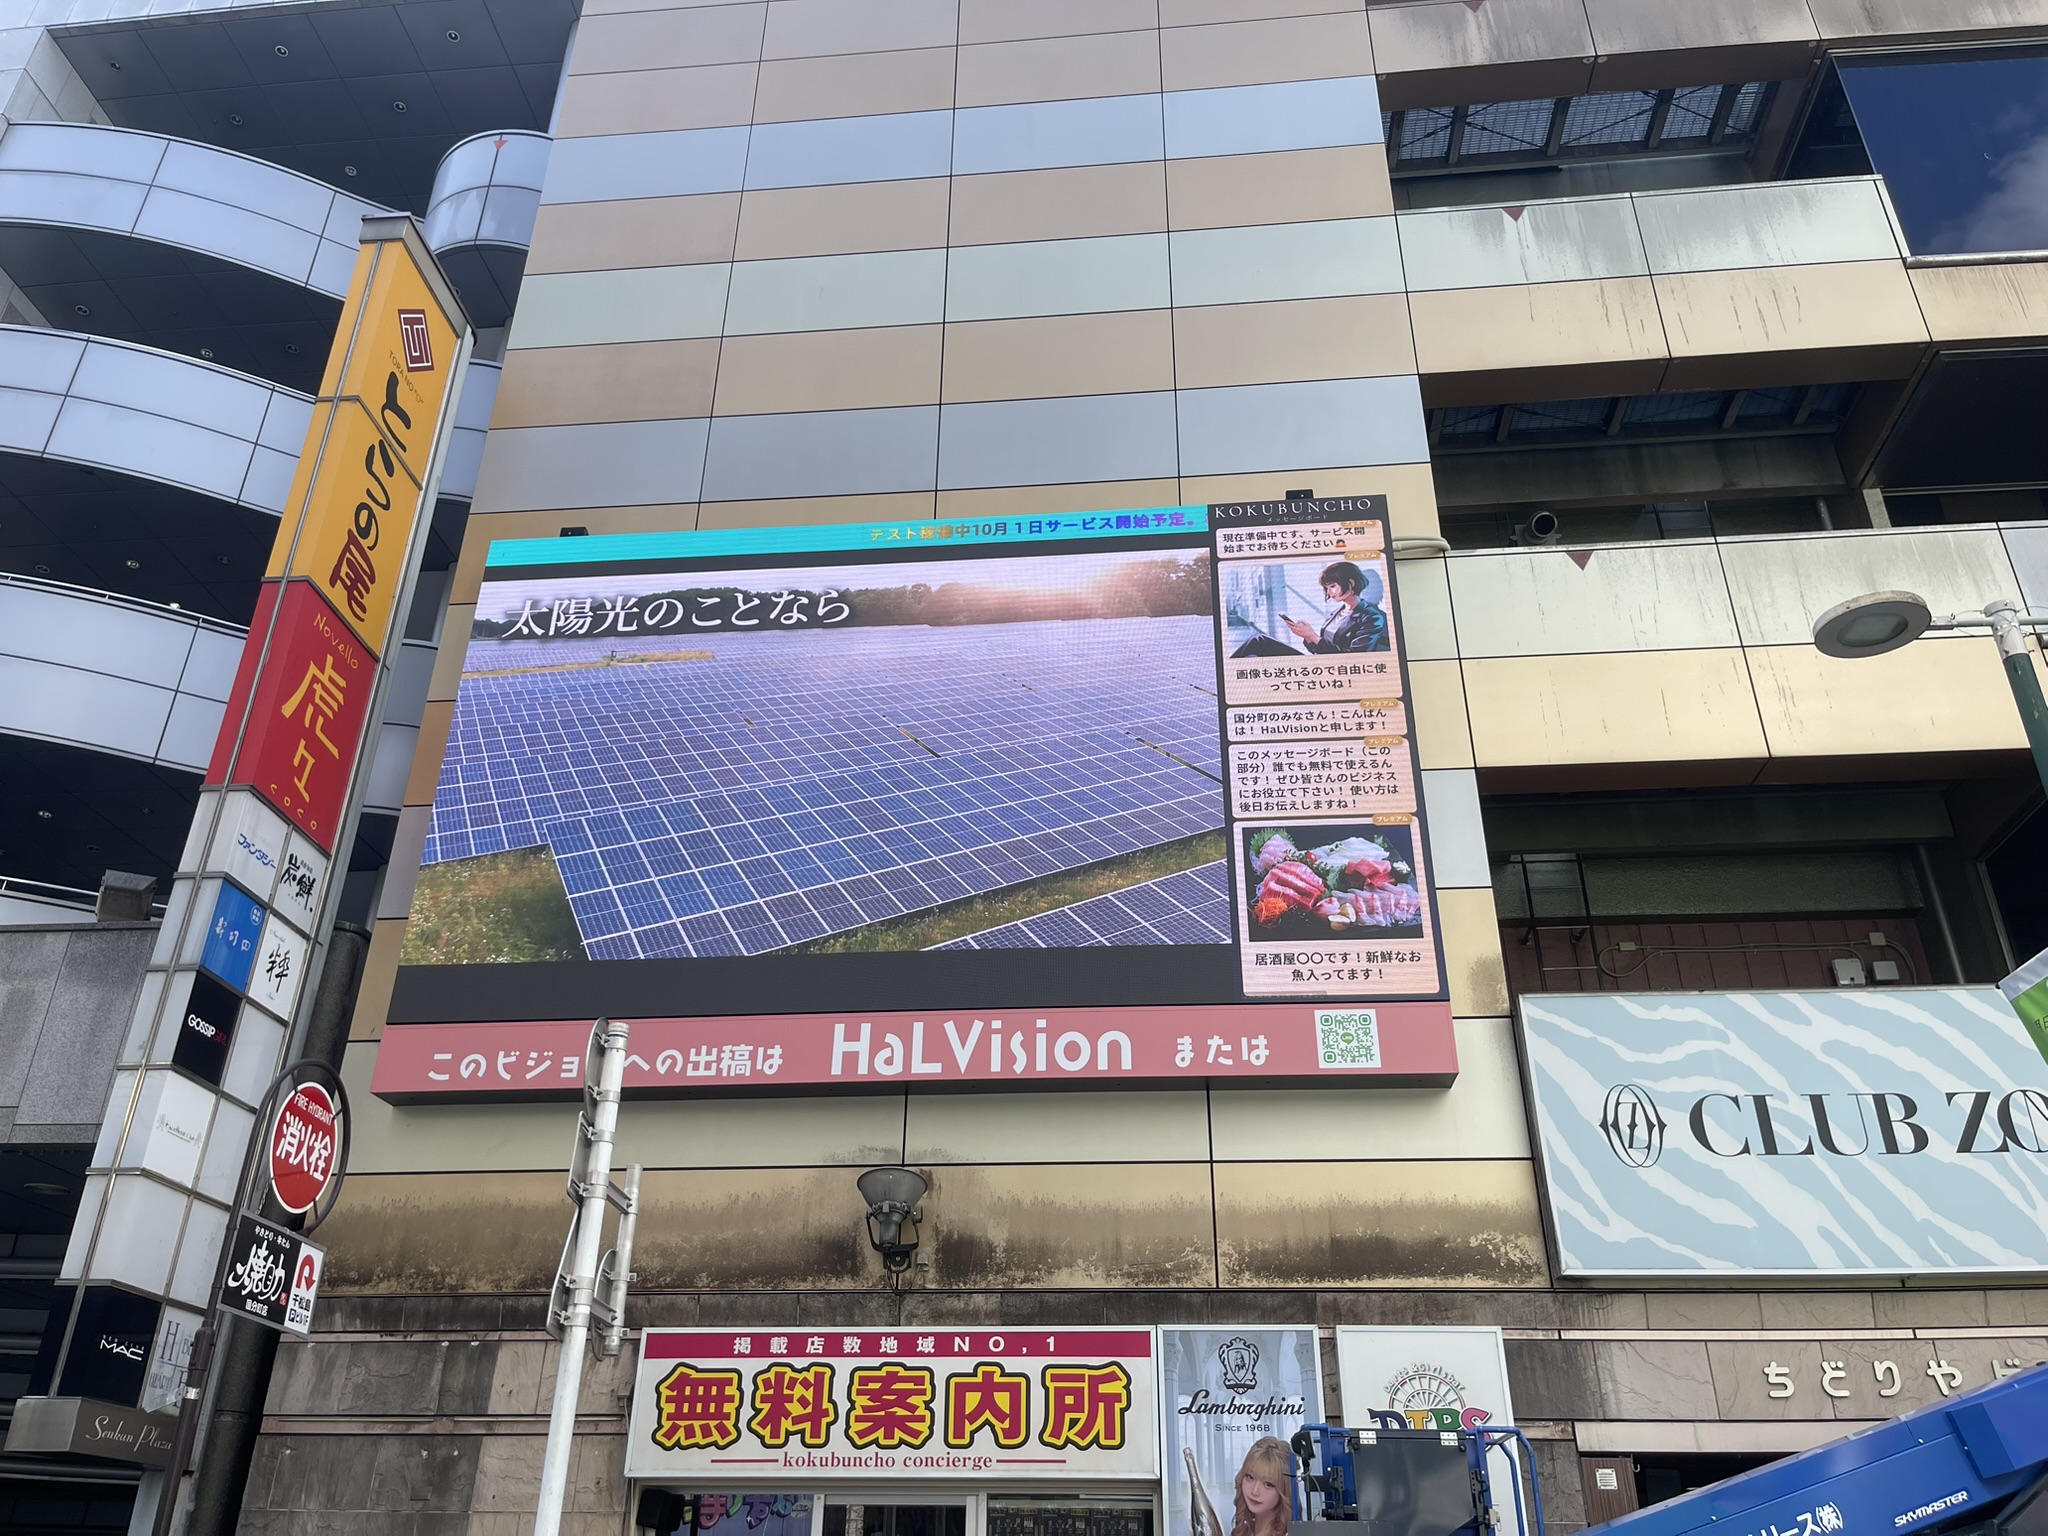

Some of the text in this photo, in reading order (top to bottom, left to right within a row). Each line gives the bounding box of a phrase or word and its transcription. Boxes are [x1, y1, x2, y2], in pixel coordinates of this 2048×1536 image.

[1215, 498, 1371, 518] KOKUBUNCHO
[1267, 514, 1328, 523] メッセージボード
[1223, 527, 1366, 542] 現在準備中です、サービス開
[1223, 539, 1334, 553] 始までお待ちください
[502, 588, 851, 638] 太陽光のことなら
[313, 612, 359, 670] Novello
[1236, 663, 1387, 679] 画像も送れるので自由に使
[1270, 678, 1352, 691] って下さいね！
[1234, 709, 1386, 723] 国分町のみなさん！こんばん
[1237, 745, 1390, 760] このメッセージボード（この
[1239, 799, 1356, 812] 後日お伝えしますね！
[1291, 968, 1383, 982] 魚入ってます！
[831, 1018, 1133, 1076] HaLVision
[1175, 1034, 1271, 1068] または
[427, 1044, 783, 1081] このビジョへの出稿は
[294, 1092, 333, 1126] FIRE HYDRANT
[1688, 1092, 1929, 1157] CLUB
[276, 1110, 331, 1182] 消火栓
[245, 1298, 269, 1316] 国分町店
[100, 1339, 144, 1360] MAC
[652, 1360, 1131, 1451] 無料案内所
[1178, 1389, 1306, 1421] Lamborghini
[85, 1415, 172, 1452] Senkan Plaza
[1245, 1424, 1271, 1432] 1968
[783, 1451, 993, 1471] kokubuncho concierge
[1894, 1490, 1969, 1528] SKYMASTER
